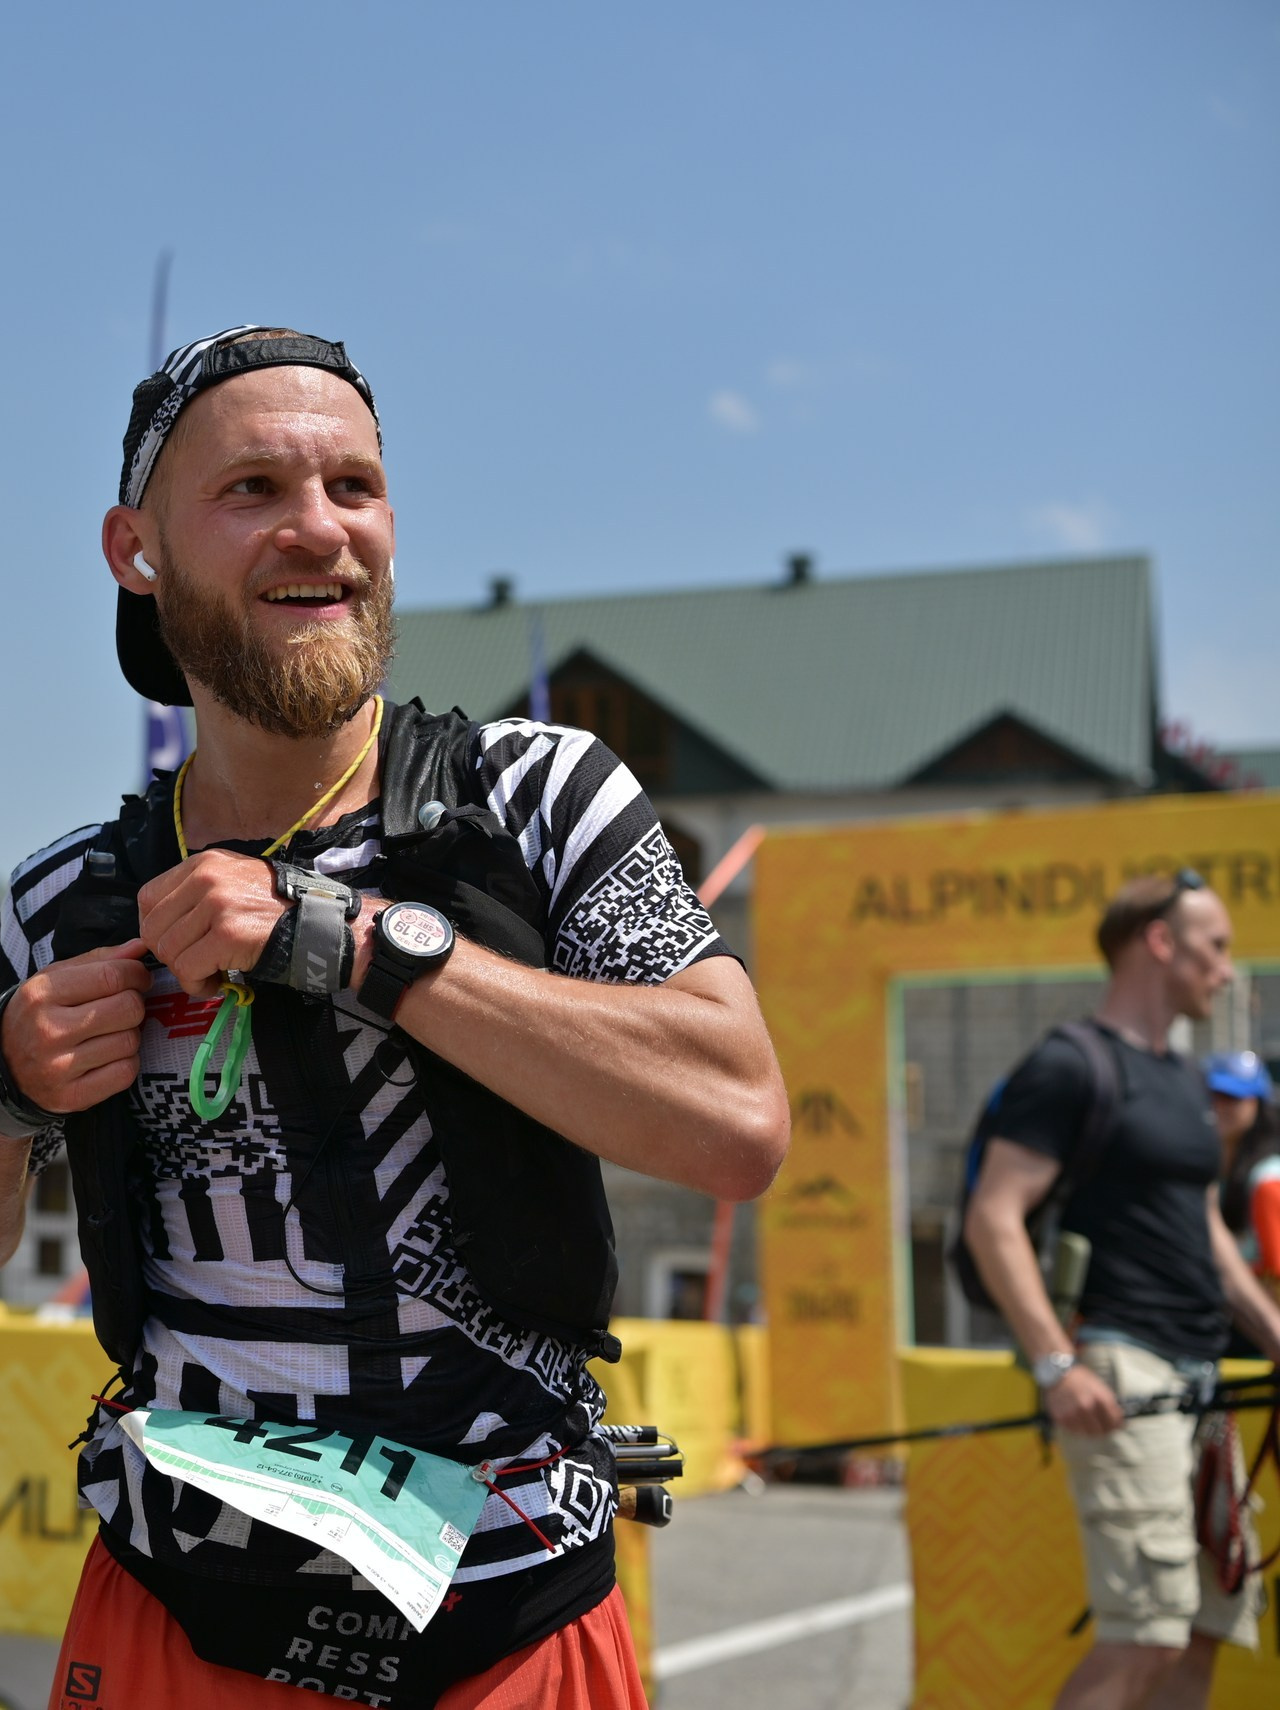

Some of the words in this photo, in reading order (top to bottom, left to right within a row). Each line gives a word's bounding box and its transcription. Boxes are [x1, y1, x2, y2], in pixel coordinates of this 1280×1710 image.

[393, 920, 432, 947] 13:19
[203, 1416, 417, 1502] 4211
[257, 1463, 293, 1477] 377-54-12
[294, 1472, 311, 1482] (915)
[284, 1636, 401, 1683] RESS
